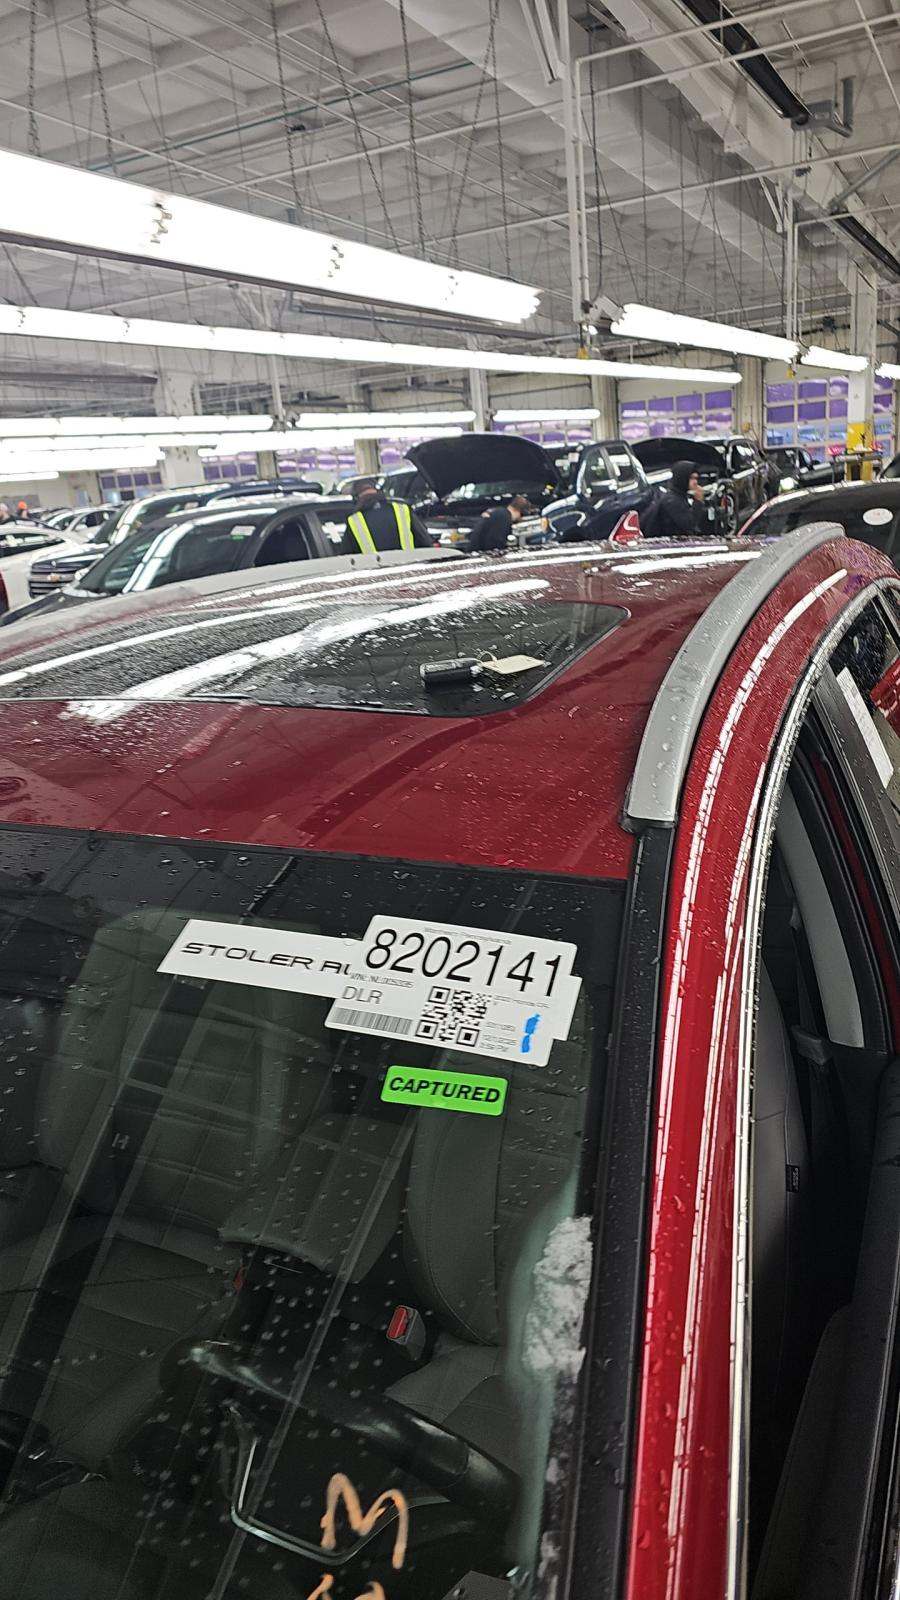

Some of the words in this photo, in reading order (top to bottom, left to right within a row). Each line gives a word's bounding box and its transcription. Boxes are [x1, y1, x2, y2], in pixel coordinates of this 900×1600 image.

[182, 942, 313, 969] STOLER
[366, 928, 562, 997] 8202141
[341, 986, 384, 1005] DLR
[389, 1077, 501, 1103] CAPTURED
